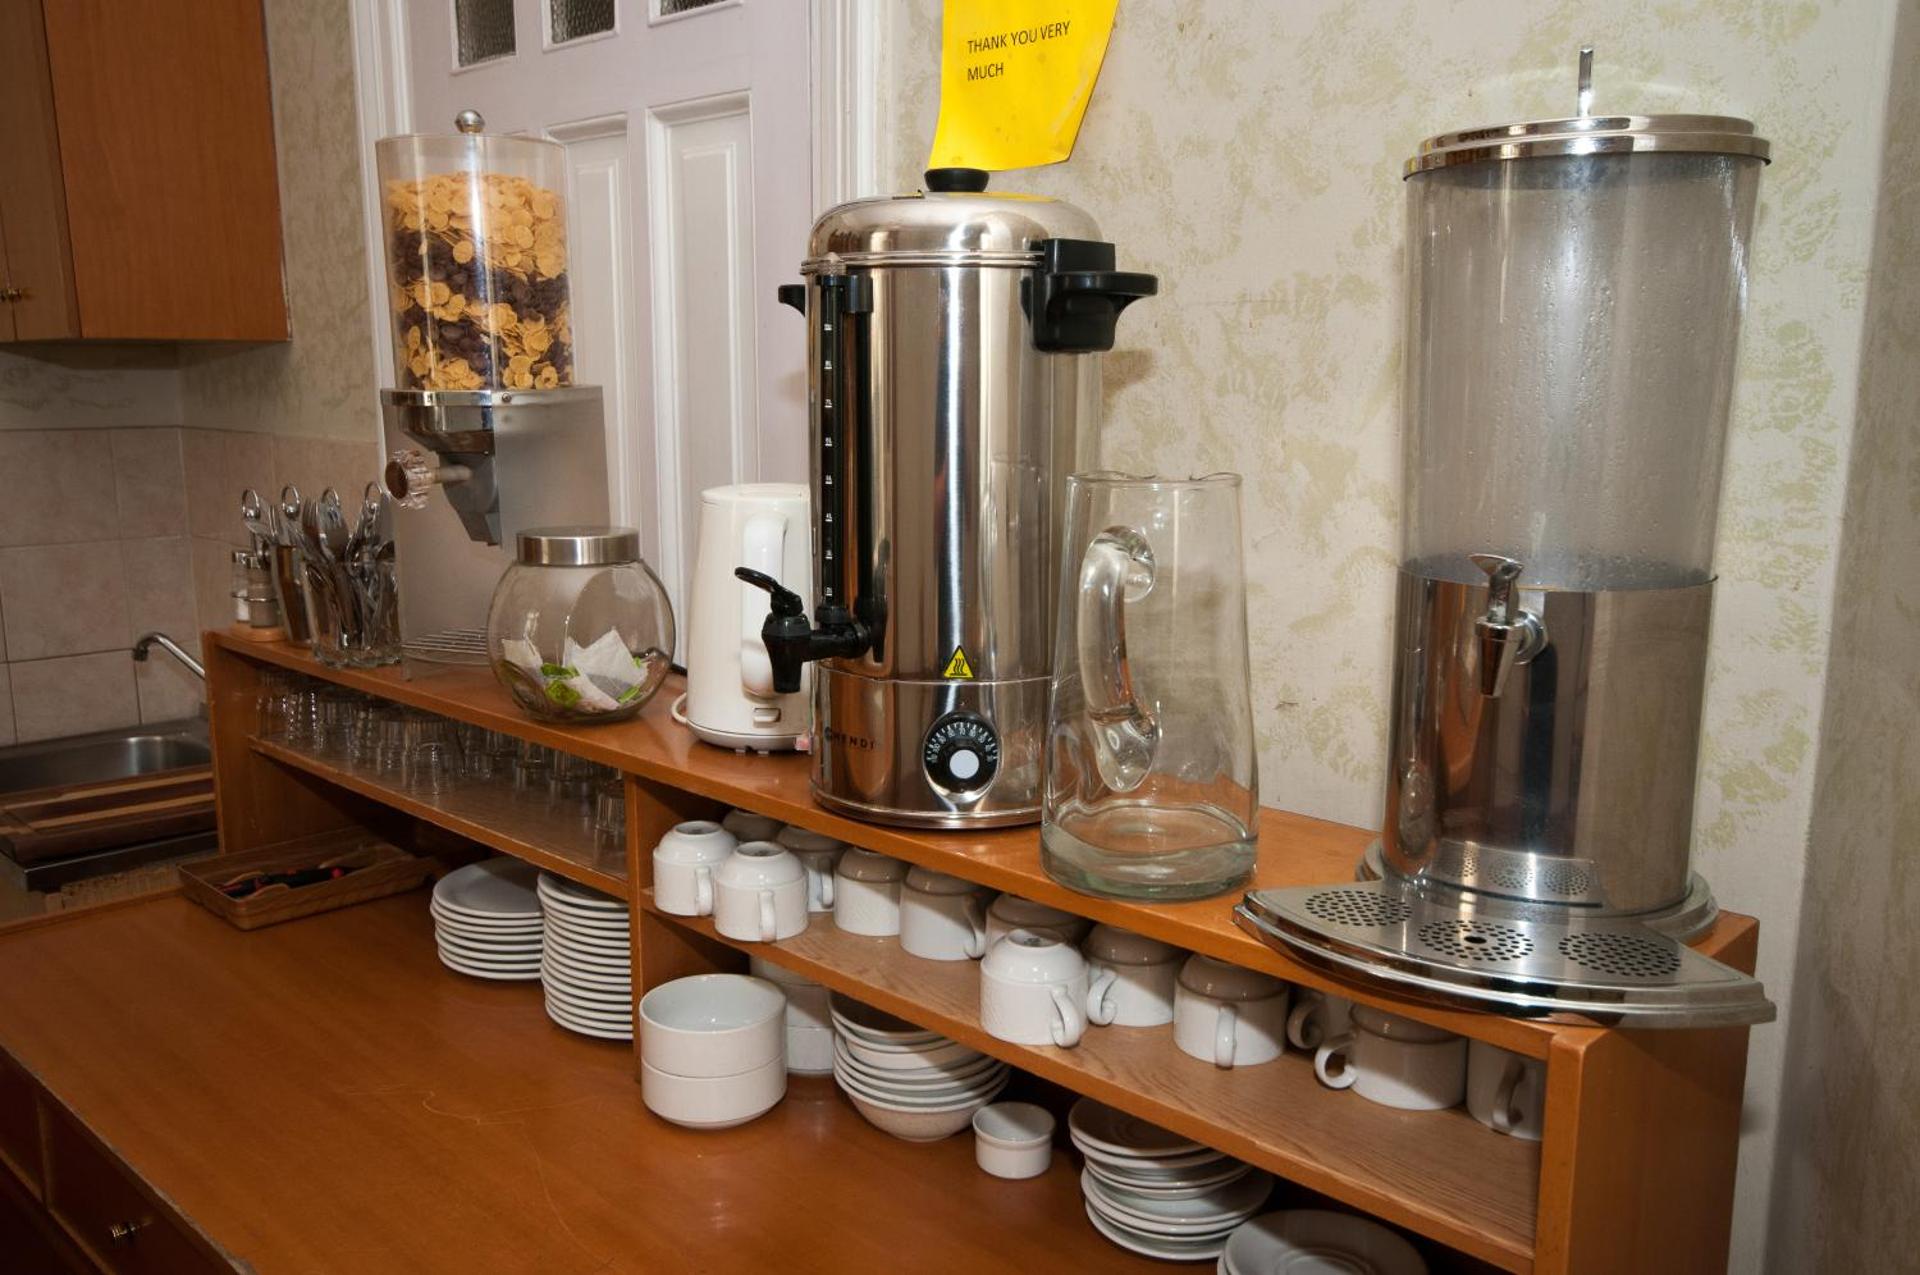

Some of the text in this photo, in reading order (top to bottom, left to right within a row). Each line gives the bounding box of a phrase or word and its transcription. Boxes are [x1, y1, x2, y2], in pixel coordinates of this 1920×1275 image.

[967, 20, 1071, 54] THANK YOU VERY
[967, 62, 1004, 81] MUCH
